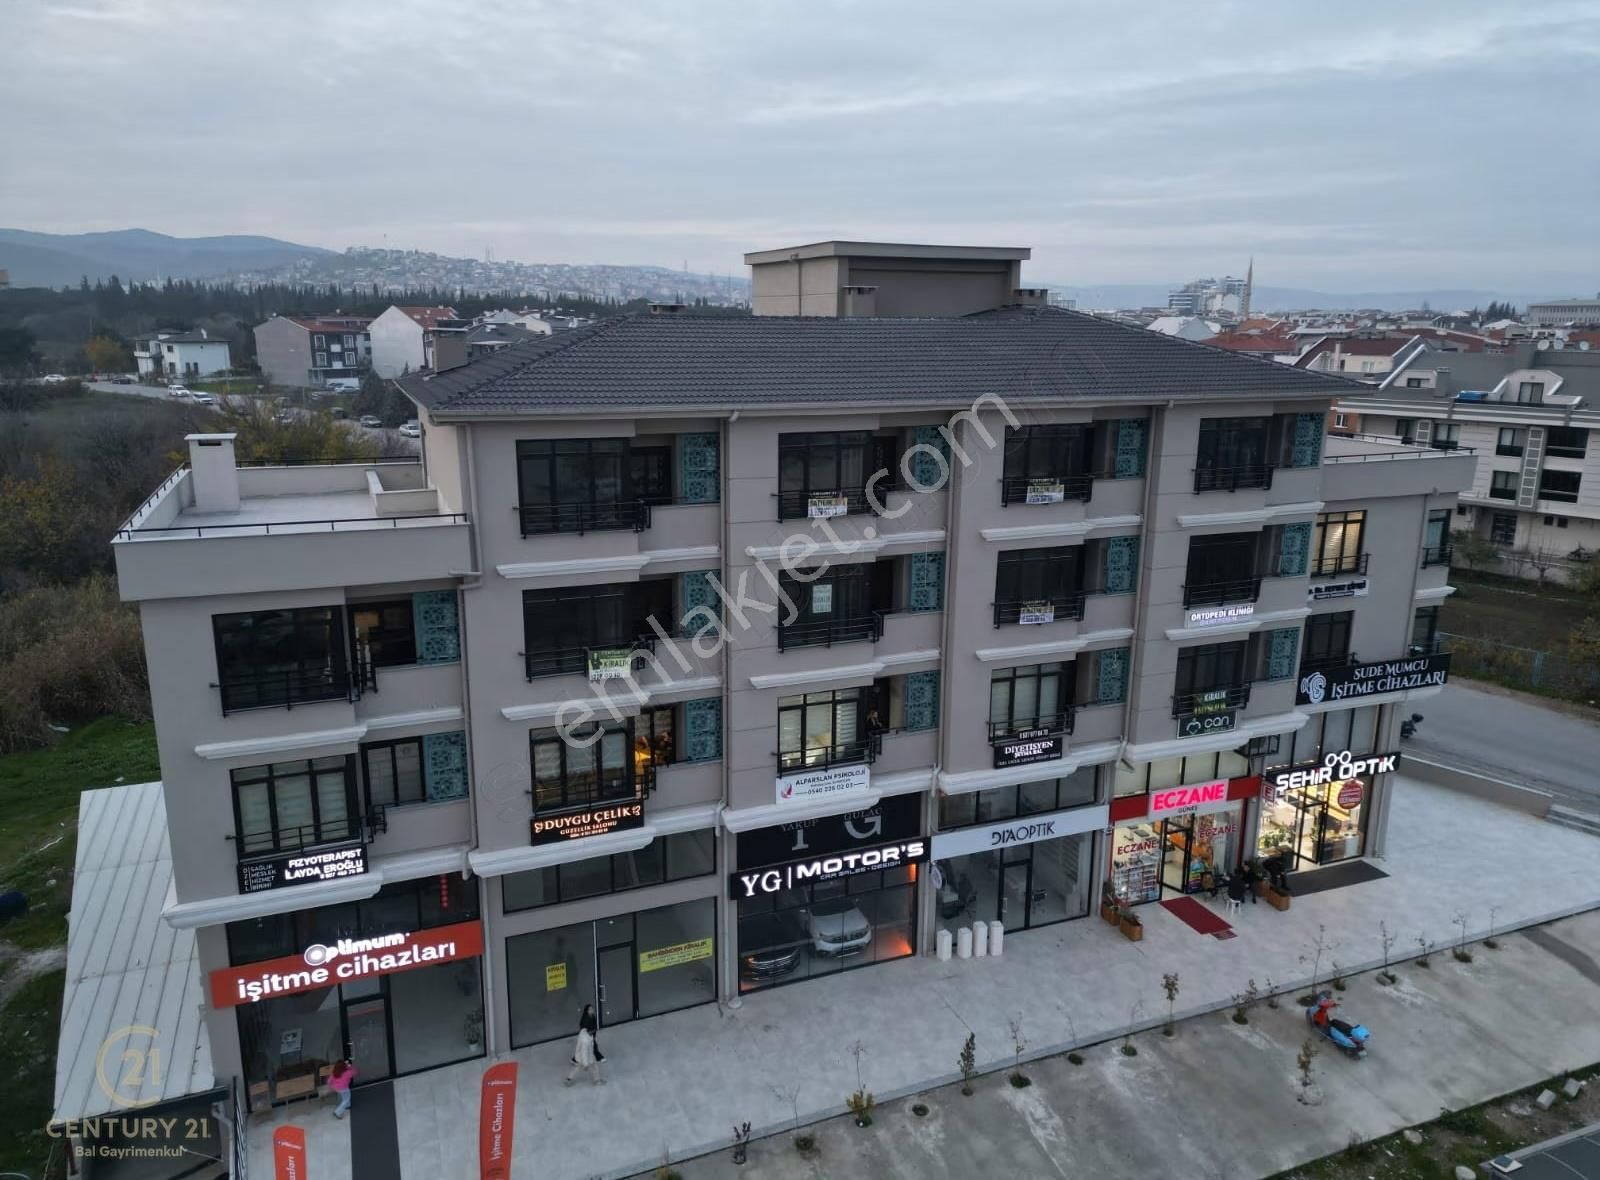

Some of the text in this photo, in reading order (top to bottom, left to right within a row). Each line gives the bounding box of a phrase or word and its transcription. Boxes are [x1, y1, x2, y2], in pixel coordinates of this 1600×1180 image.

[1353, 659, 1429, 681] SUDE MUMCU
[1331, 670, 1446, 699] İŞİTME CİHAZLARI
[1204, 715, 1230, 728] can
[1153, 783, 1225, 811] ECZANE
[545, 806, 631, 830] DUYGU ÇELİK
[1199, 824, 1238, 839] ECZANE
[1117, 839, 1158, 855] ECZANE
[741, 842, 925, 897] YG MOTOR'S
[304, 932, 405, 966] Optimum
[238, 941, 456, 1002] işitme cihazları
